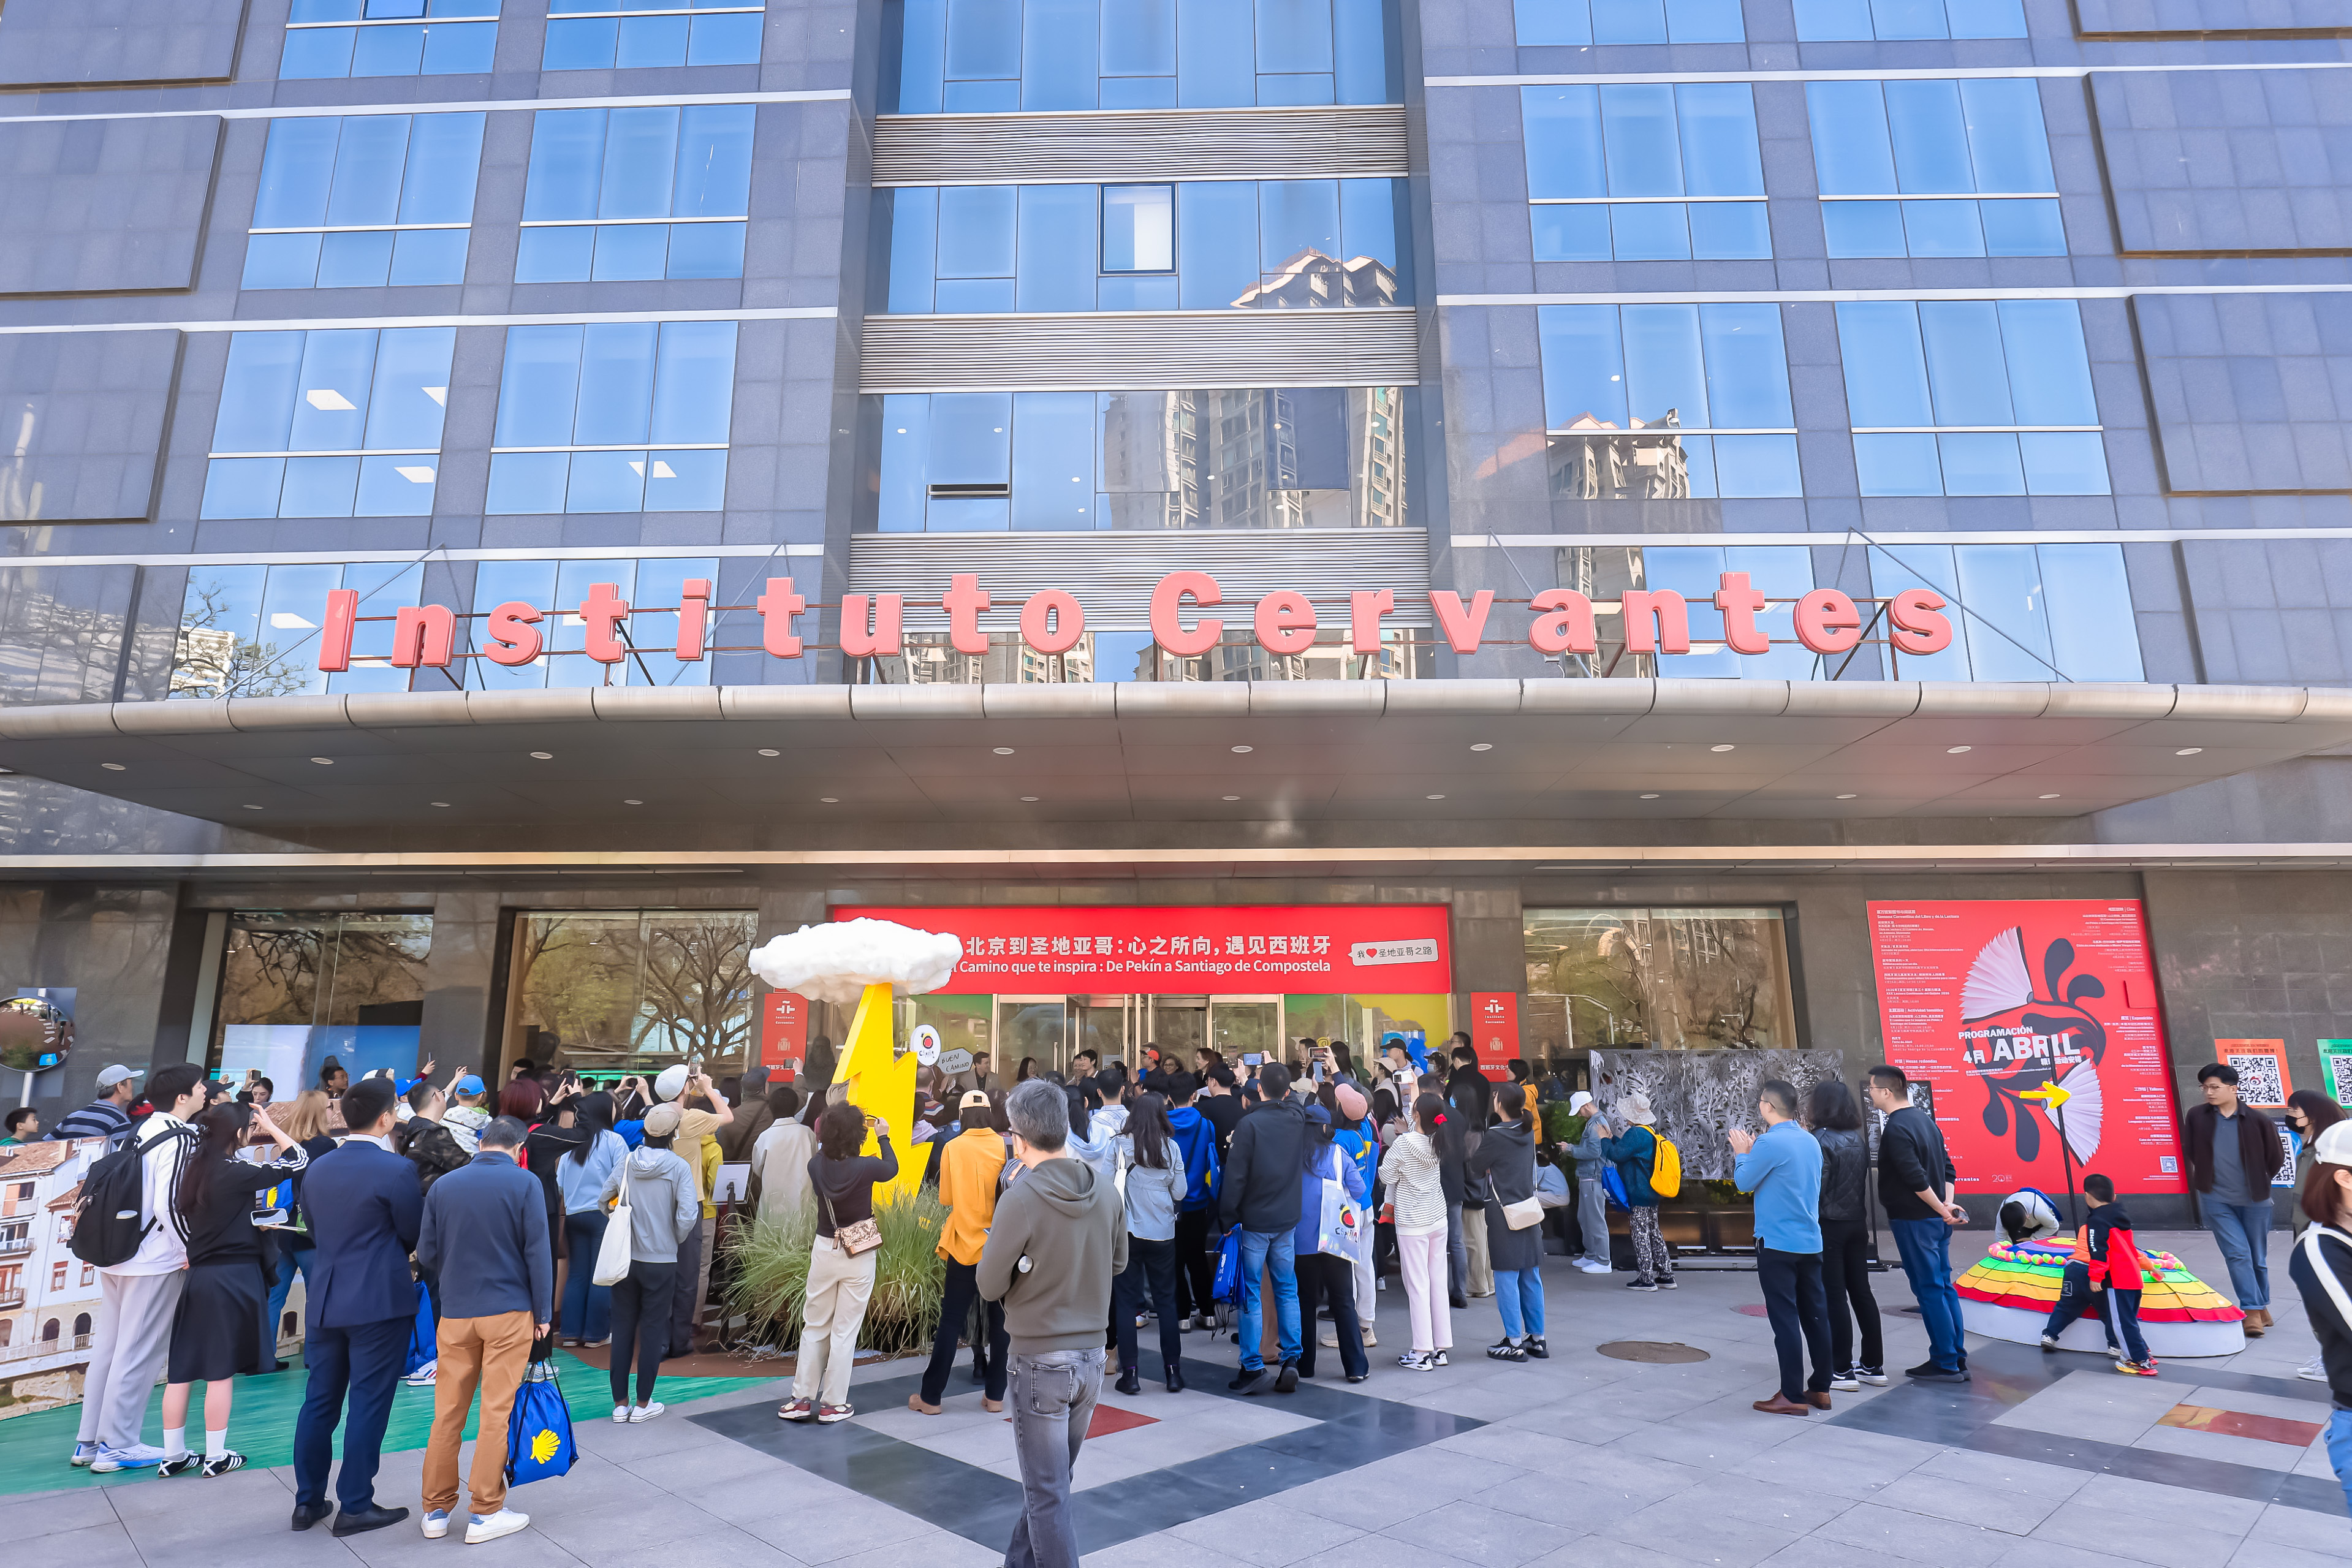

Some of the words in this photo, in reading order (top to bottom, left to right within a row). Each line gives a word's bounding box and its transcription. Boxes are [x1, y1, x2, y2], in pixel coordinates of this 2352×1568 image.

[318, 573, 1085, 672] Instituto
[1149, 570, 1953, 656] Cervantes
[966, 936, 1330, 956] 北京到圣地亚哥：心之所向，遇见西班牙
[1357, 950, 1366, 960] 我
[1378, 946, 1432, 958] 圣地亚哥之路
[960, 960, 1011, 972] Camino
[1013, 963, 1035, 975] que
[1038, 961, 1052, 972] te
[1053, 960, 1097, 975] inspira
[1107, 960, 1123, 972] De
[1126, 958, 1162, 972] Pekín
[1164, 963, 1172, 972] a
[1175, 960, 1232, 975] Santiago
[1234, 959, 1251, 972] de
[1253, 960, 1330, 975] Compostela
[1958, 1025, 2033, 1039] PROGRAMACIÓN
[1993, 1033, 2081, 1061] ABRIL
[941, 1053, 960, 1064] BUEN
[1963, 1050, 1986, 1064] 4月
[946, 1061, 969, 1072] CAMINO
